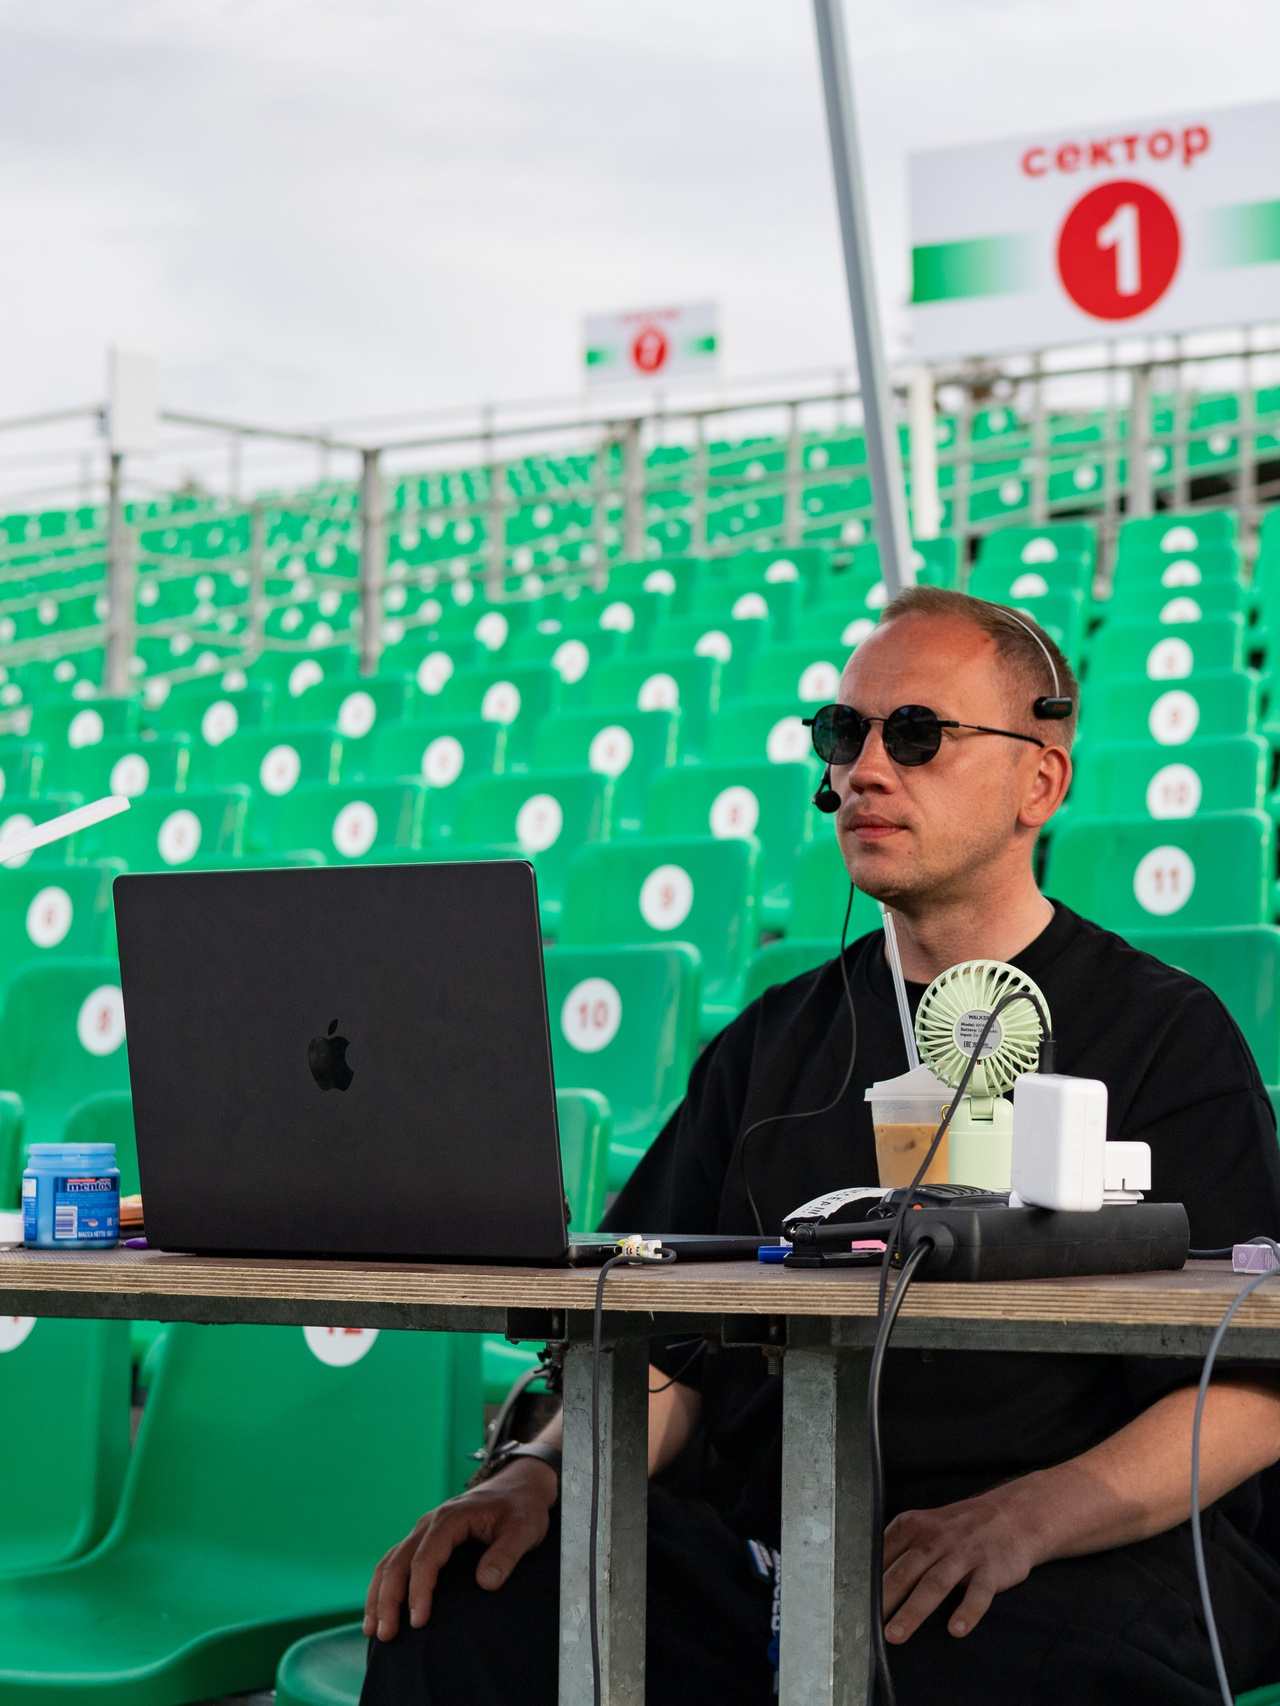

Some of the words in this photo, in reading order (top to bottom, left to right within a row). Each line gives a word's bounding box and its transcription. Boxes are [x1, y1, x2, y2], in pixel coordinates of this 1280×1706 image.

[1020, 123, 1211, 179] сектор
[1096, 201, 1142, 297] 1
[1152, 866, 1181, 895] 11
[577, 999, 610, 1031] 10
[67, 1180, 111, 1192] mentos
